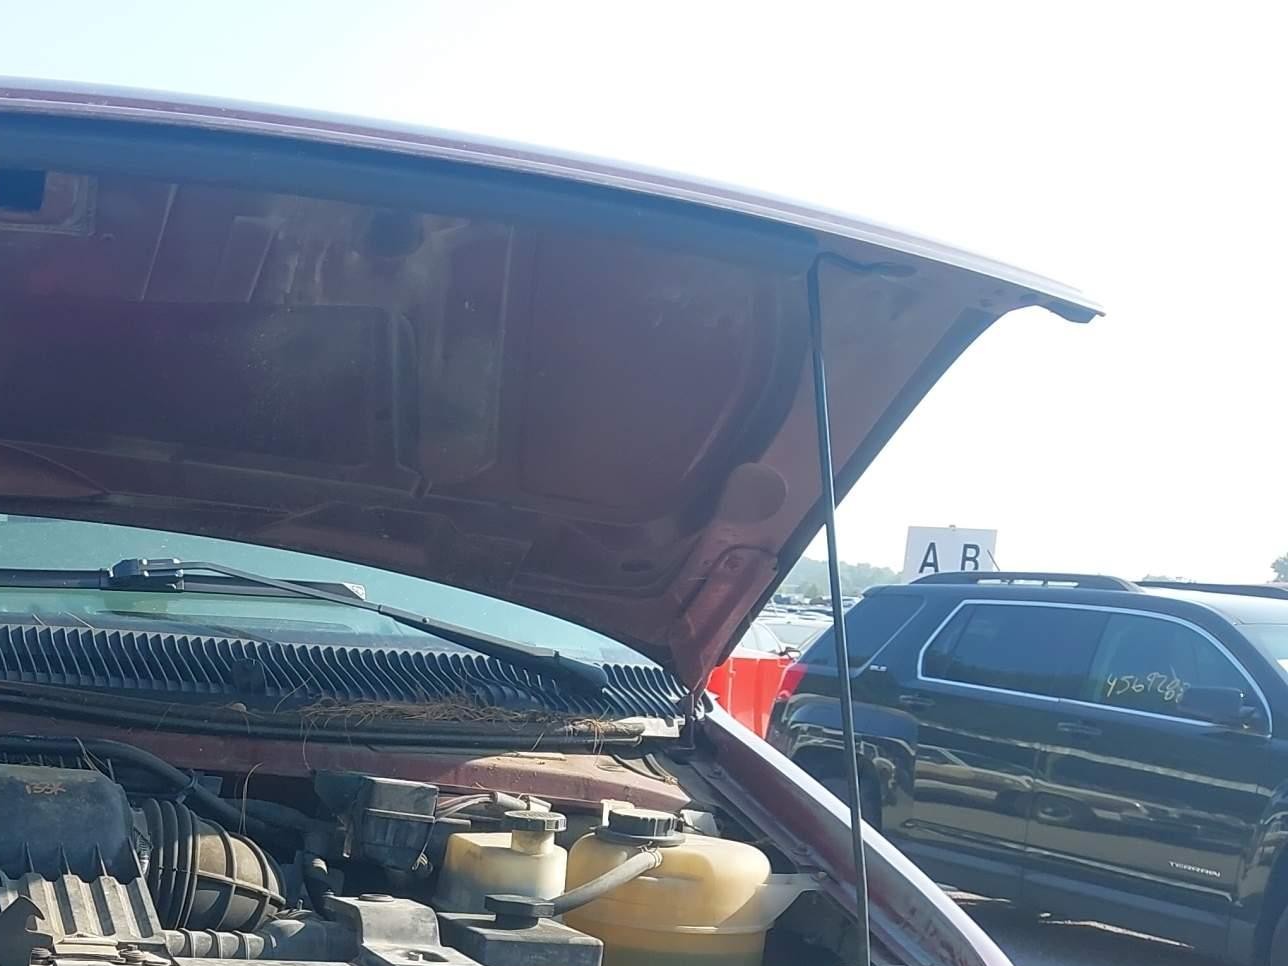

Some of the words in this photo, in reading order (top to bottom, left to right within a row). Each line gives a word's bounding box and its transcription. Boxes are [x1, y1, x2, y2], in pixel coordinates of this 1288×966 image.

[918, 541, 940, 574] A
[960, 543, 981, 571] B
[1168, 860, 1221, 877] TERRAIN
